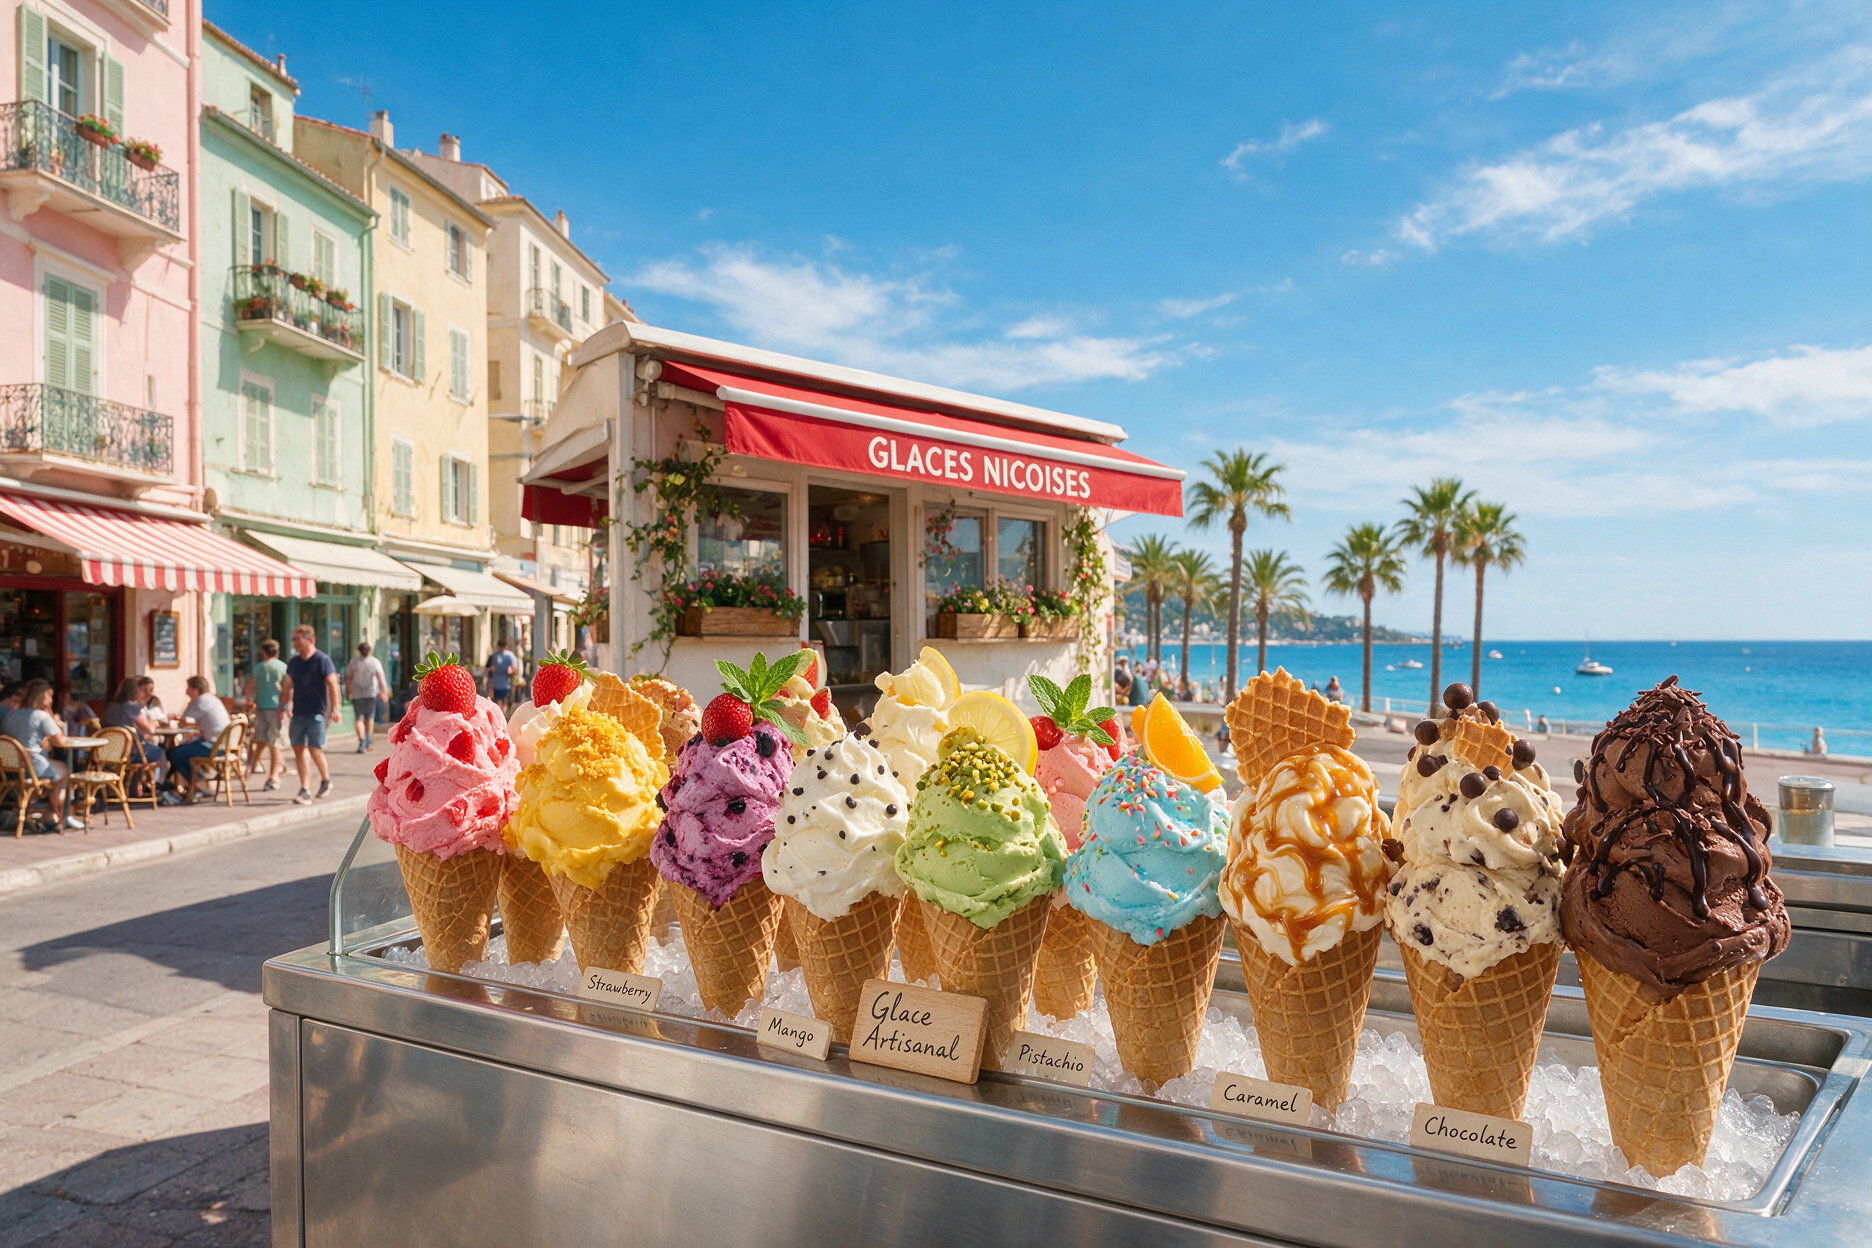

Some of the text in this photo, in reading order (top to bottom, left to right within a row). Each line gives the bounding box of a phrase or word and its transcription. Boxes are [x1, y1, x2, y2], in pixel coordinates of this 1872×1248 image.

[868, 436, 1091, 499] GLACES NICOISES
[587, 974, 652, 1005] Strawberry
[871, 990, 933, 1026] Glace
[767, 1016, 814, 1048] Mango
[862, 1024, 960, 1061] Artisanal
[1018, 1043, 1084, 1072] Pistachio
[1223, 1084, 1299, 1113] Caramel
[1424, 1116, 1518, 1150] Chocolate
